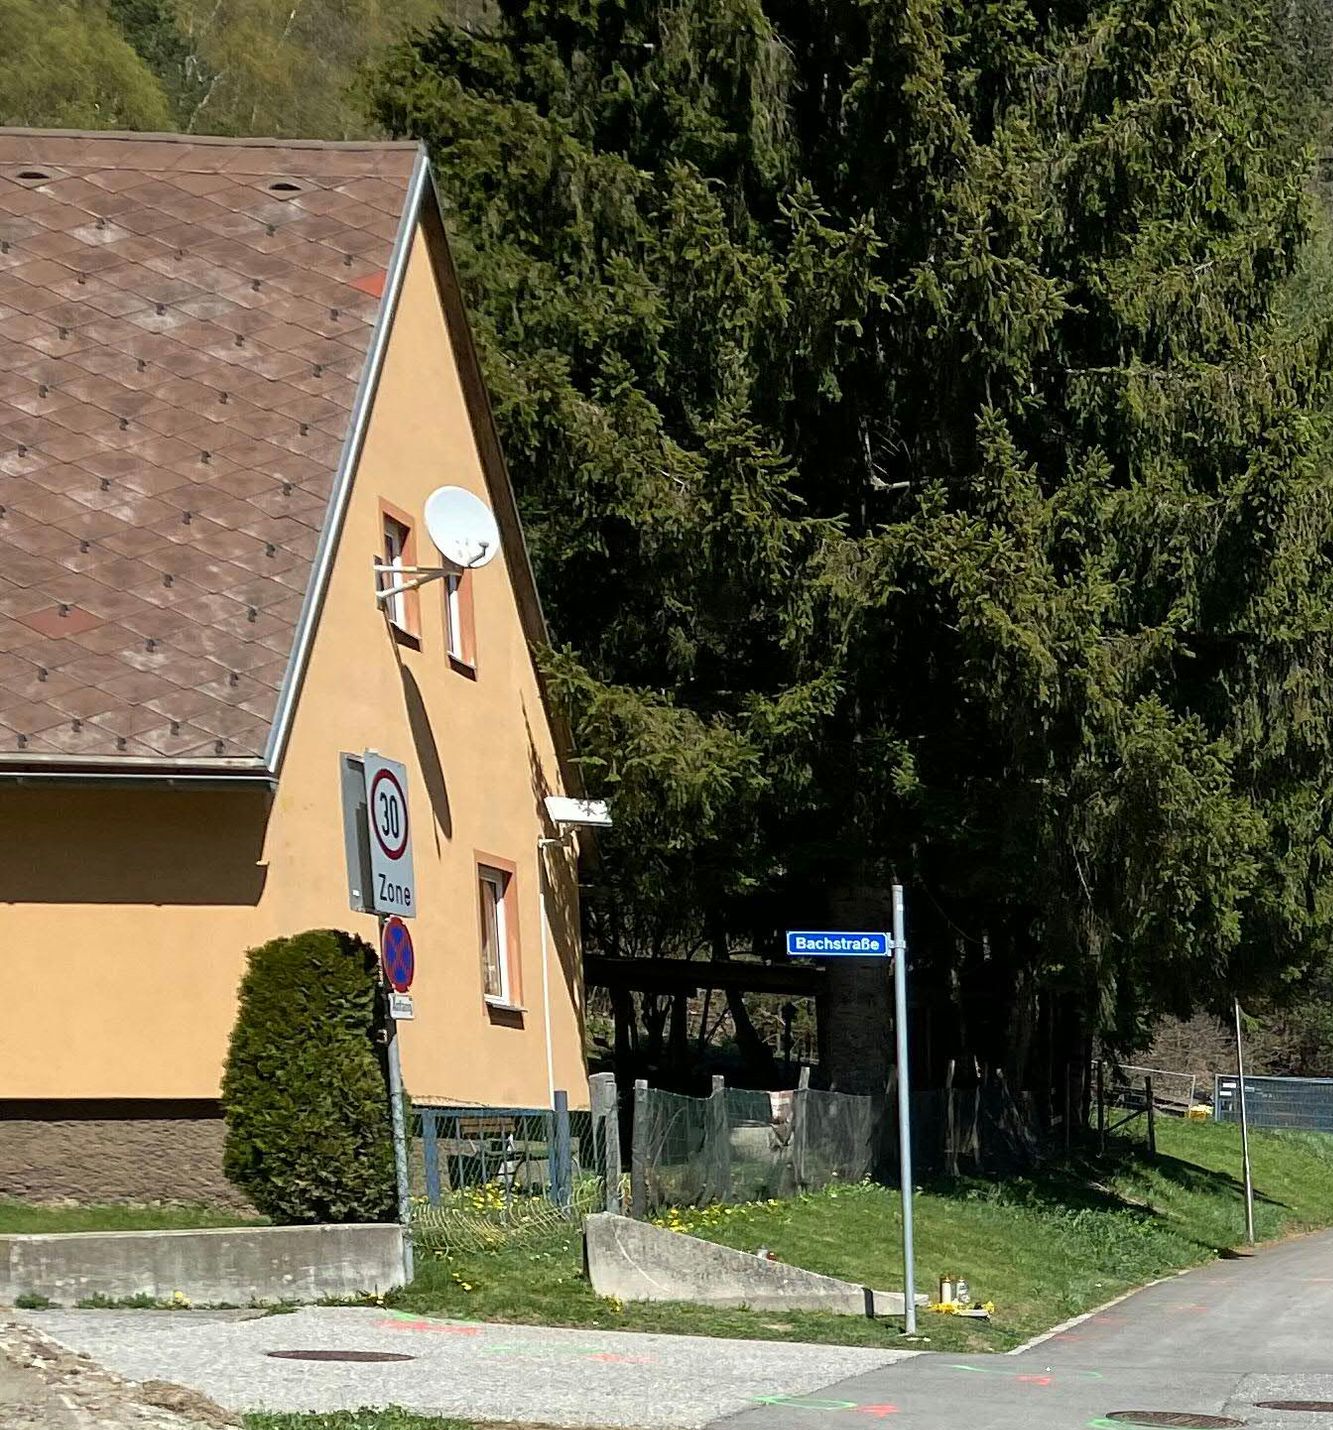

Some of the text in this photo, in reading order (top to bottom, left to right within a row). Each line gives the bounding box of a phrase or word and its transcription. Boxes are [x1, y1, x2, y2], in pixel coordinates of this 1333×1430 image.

[379, 791, 399, 839] 30
[378, 873, 411, 907] Zone
[795, 936, 880, 951] Bachstraße
